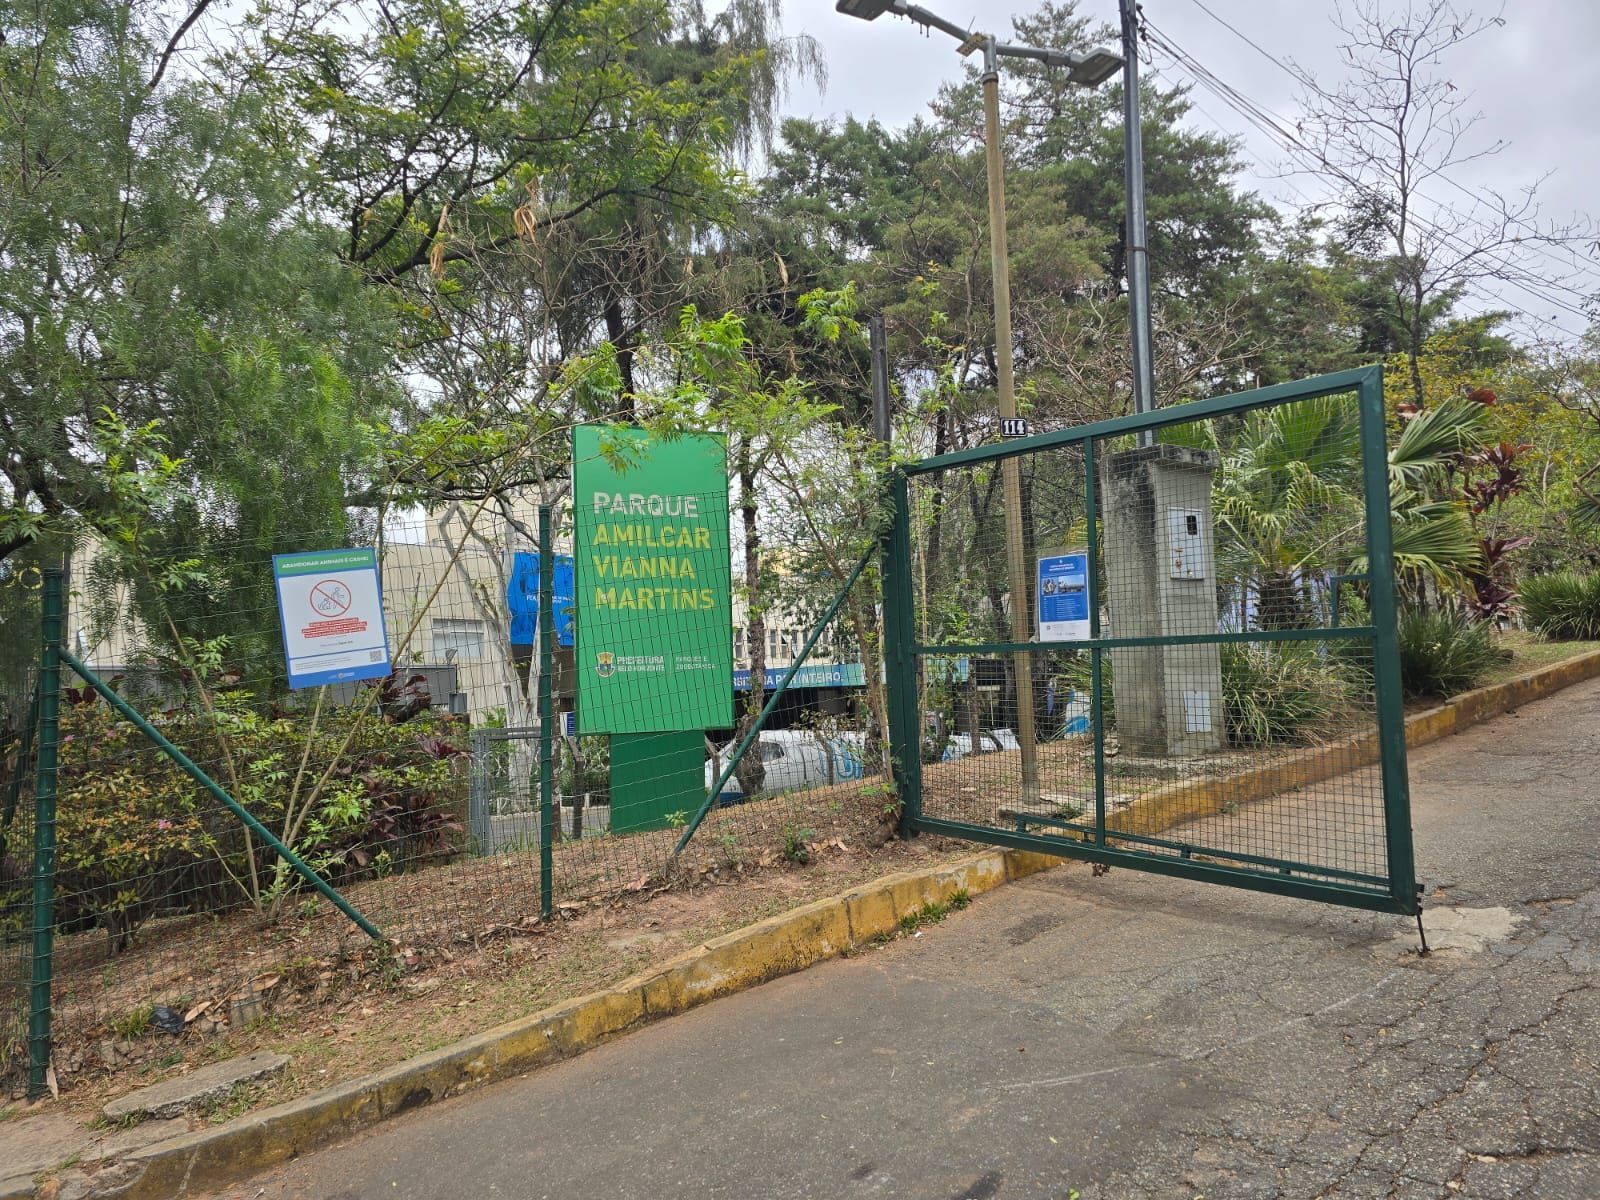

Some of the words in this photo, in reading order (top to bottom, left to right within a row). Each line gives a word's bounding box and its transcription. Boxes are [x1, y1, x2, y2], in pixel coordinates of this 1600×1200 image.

[1003, 420, 1025, 434] 114
[593, 492, 699, 518] PARQUE
[593, 523, 711, 549] AMILCAR
[592, 555, 695, 579] VIANNA
[595, 587, 714, 610] MARTINS
[617, 656, 664, 665] PREFEITURA
